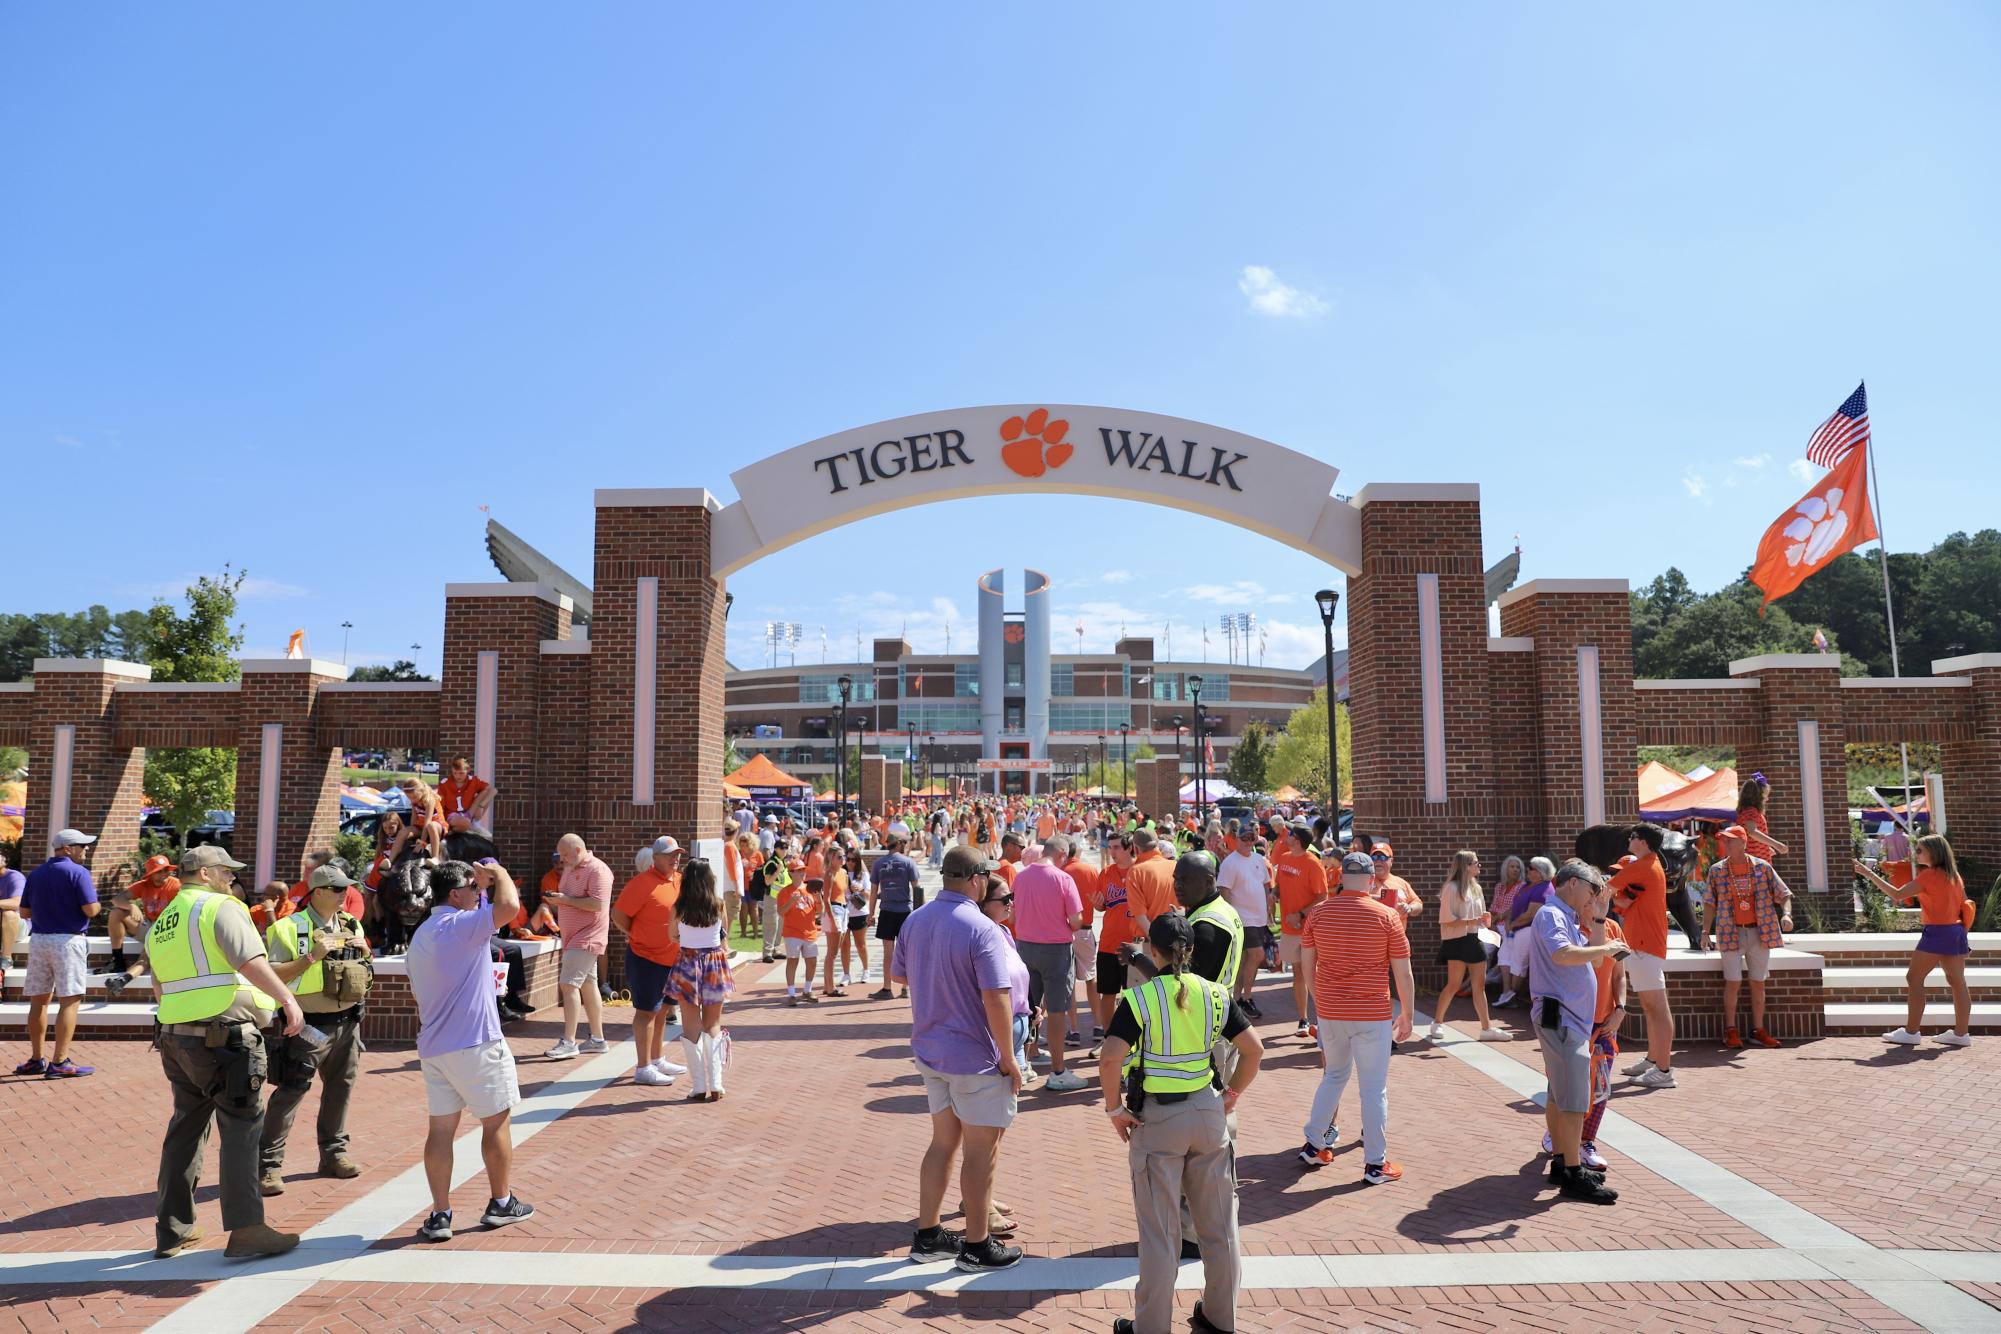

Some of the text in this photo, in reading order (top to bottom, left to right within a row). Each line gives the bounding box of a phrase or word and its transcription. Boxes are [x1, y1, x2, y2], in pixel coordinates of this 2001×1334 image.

[814, 427, 1249, 494] TIGER WALK
[154, 912, 180, 936] SLED
[155, 931, 176, 944] POLICE
